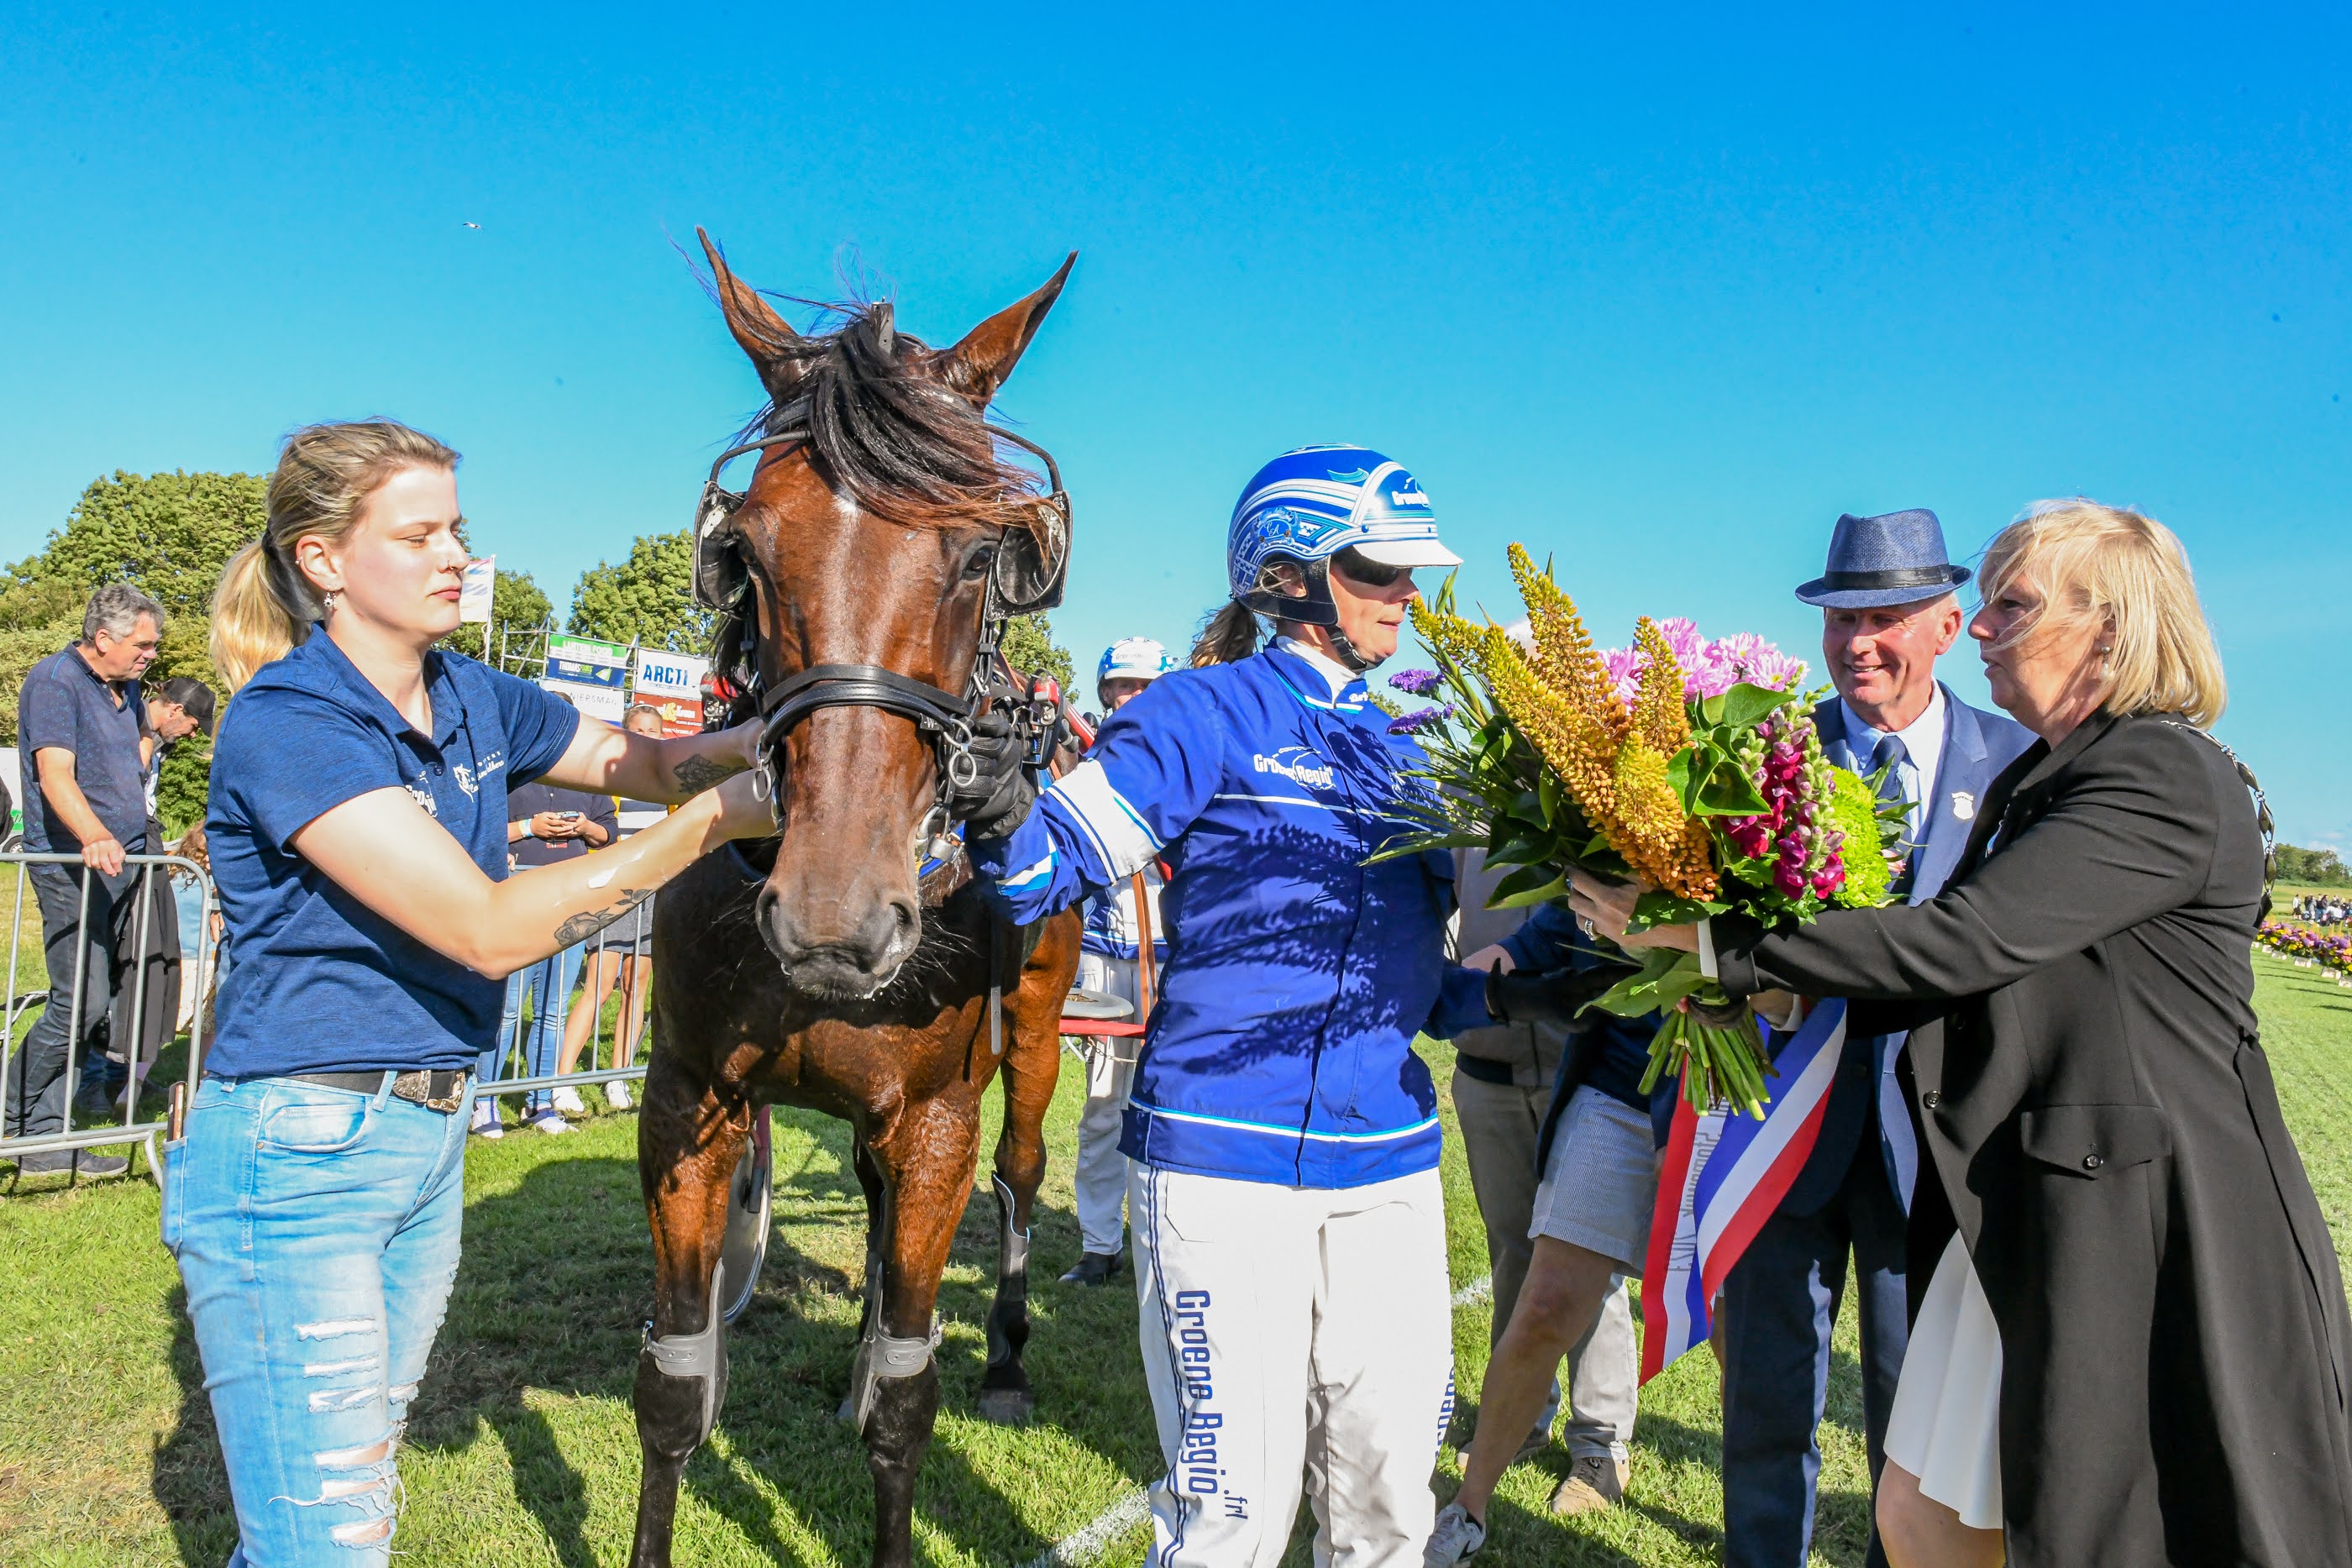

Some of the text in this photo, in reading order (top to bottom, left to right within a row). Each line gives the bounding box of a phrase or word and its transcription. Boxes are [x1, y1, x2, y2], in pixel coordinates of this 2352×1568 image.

[643, 664, 689, 686] ARCTI
[1176, 1289, 1226, 1494] Groene Regio
[1224, 1489, 1248, 1519] .frl
